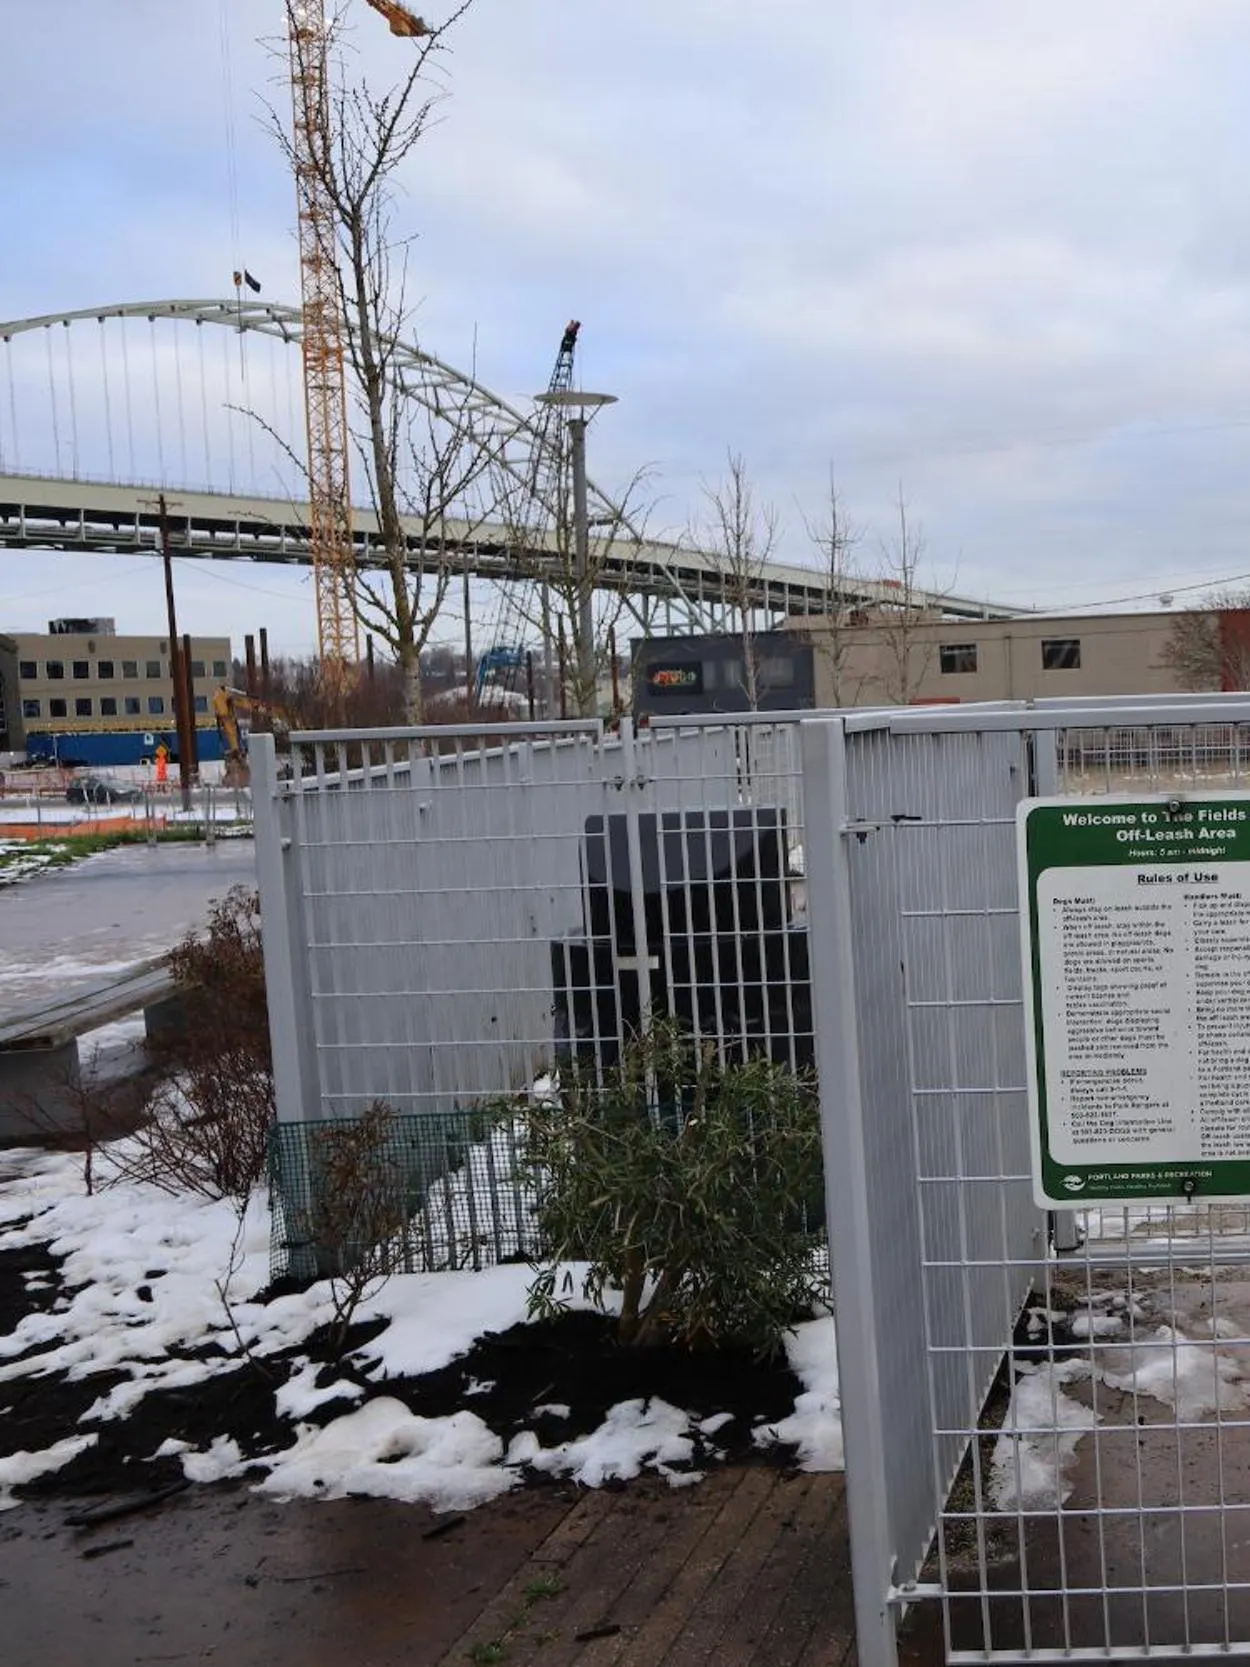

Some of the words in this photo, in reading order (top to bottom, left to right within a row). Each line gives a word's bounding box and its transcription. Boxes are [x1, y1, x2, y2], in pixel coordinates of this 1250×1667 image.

[1063, 814, 1136, 826] Welcome
[1142, 812, 1157, 822] to
[1199, 809, 1246, 821] Fields
[1116, 828, 1194, 842] Off-Leash
[1199, 828, 1236, 839] Area
[1137, 874, 1173, 885] Rules
[1177, 873, 1189, 883] of
[1194, 873, 1218, 882] Use
